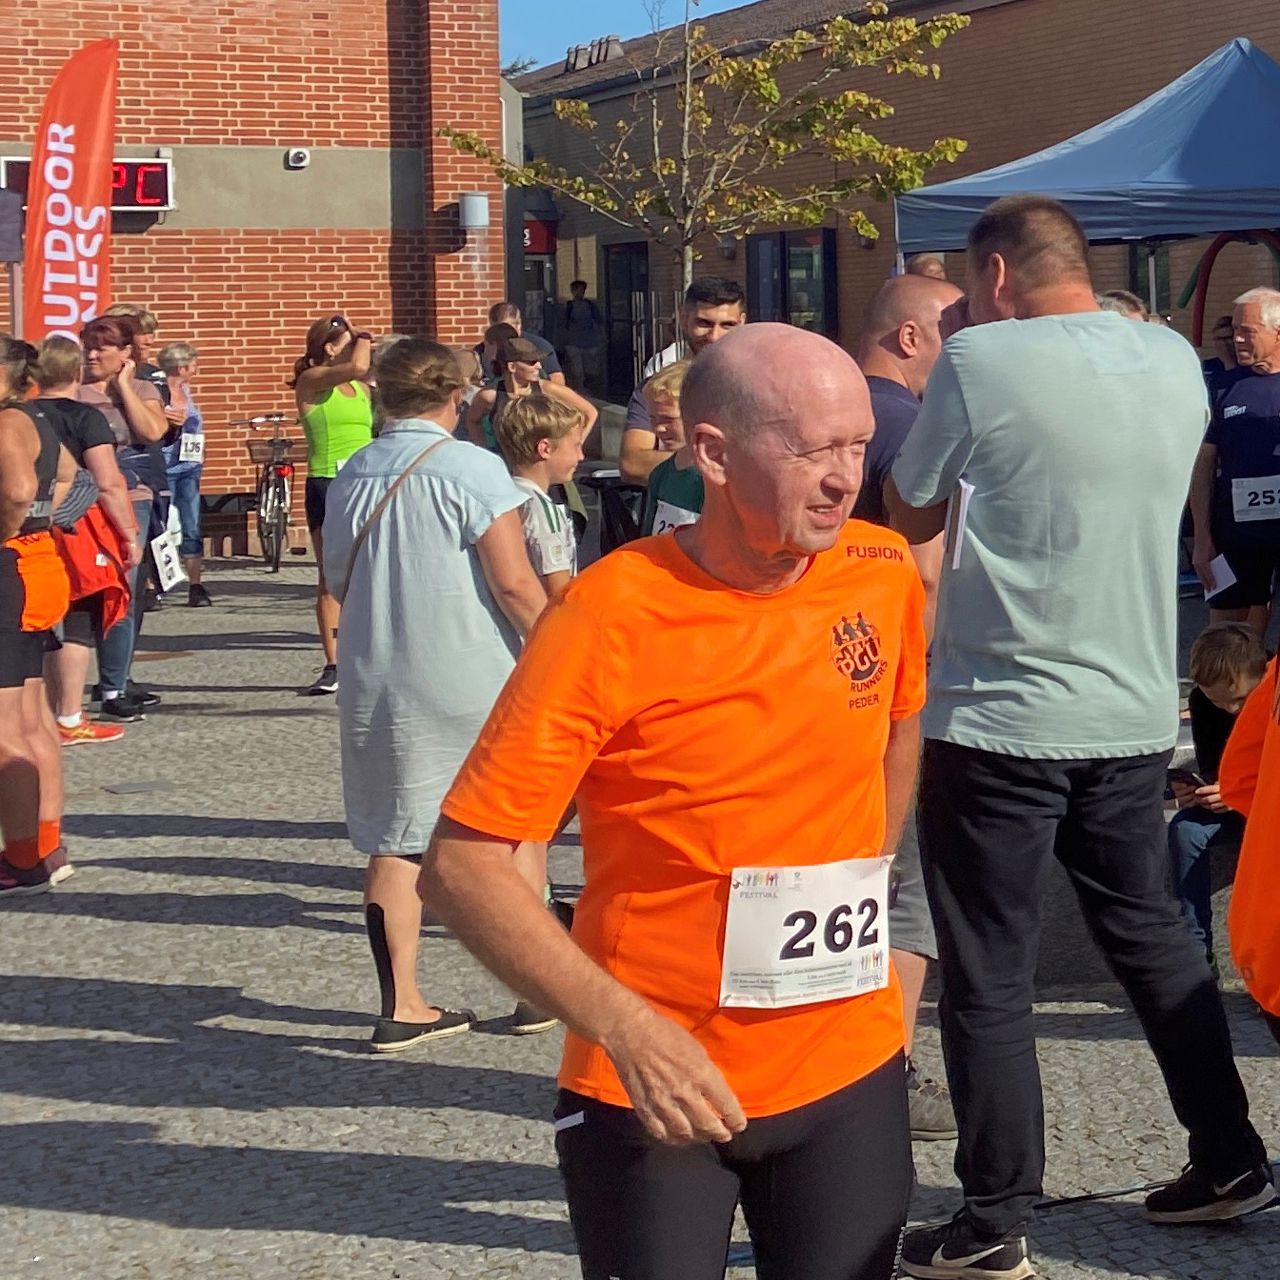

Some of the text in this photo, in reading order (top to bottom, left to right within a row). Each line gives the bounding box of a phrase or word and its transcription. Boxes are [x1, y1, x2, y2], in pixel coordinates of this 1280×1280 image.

[846, 546, 904, 563] FUSION
[850, 659, 889, 693] RUNNERS
[848, 694, 880, 710] PEDER
[778, 897, 879, 961] 262
